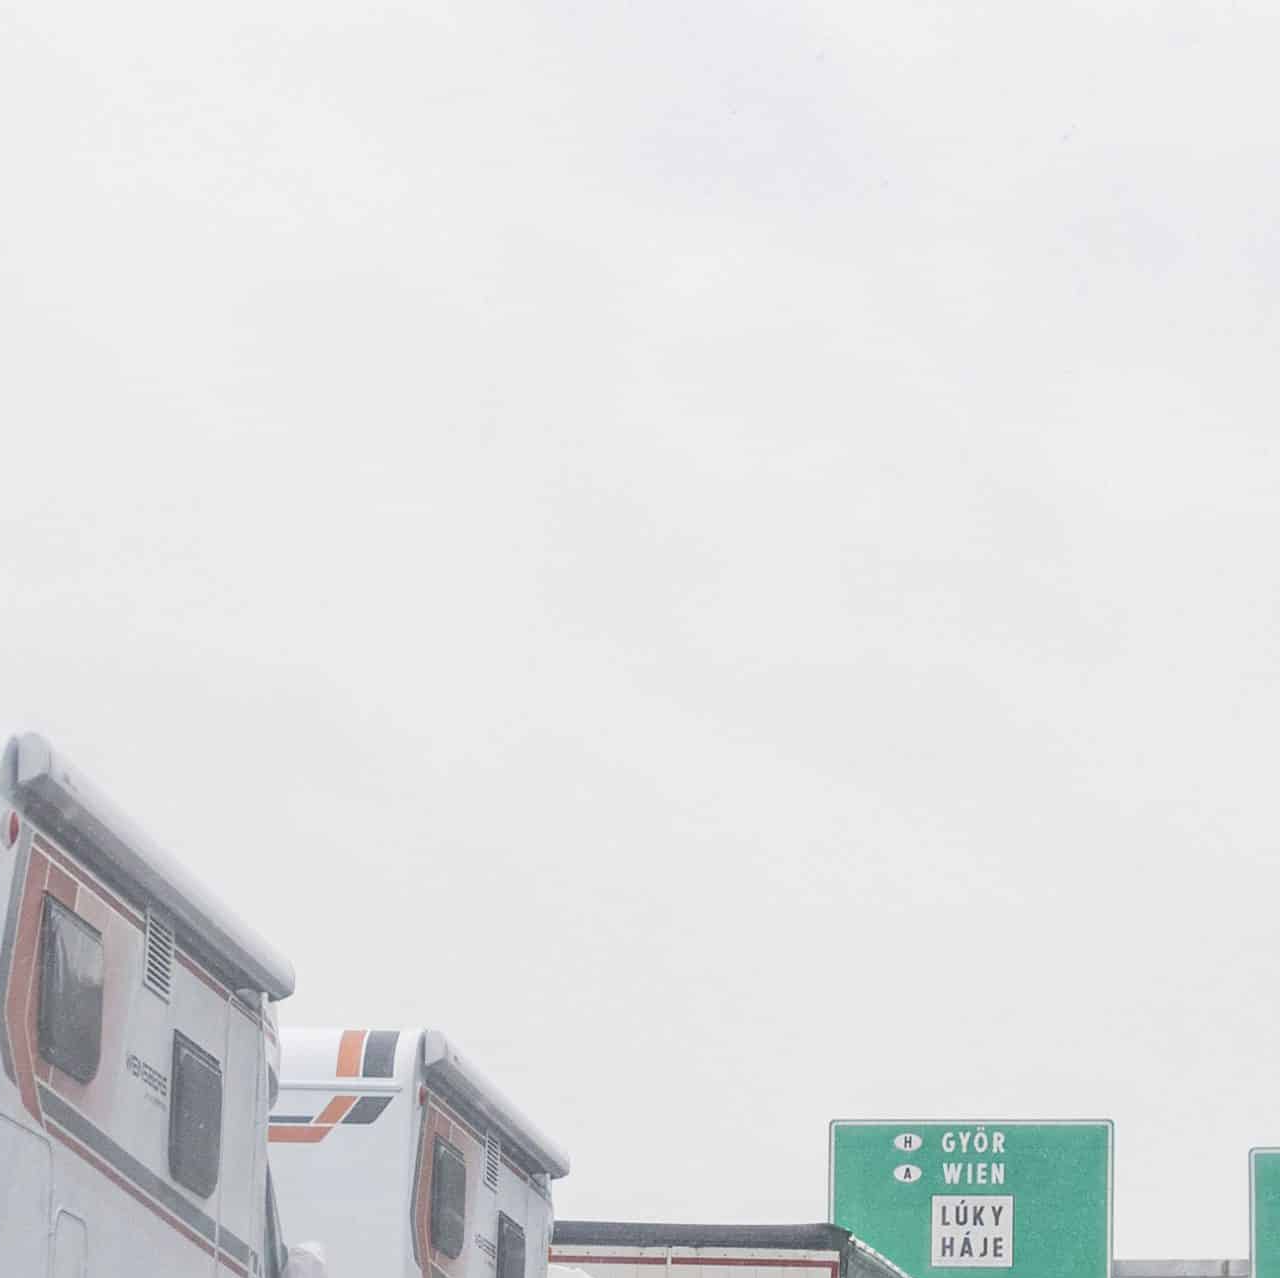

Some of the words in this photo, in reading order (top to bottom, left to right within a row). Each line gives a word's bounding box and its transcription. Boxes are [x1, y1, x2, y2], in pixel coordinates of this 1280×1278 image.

[904, 1136, 913, 1149] H
[903, 1167, 913, 1180] A
[942, 1163, 1005, 1184] WIEN
[940, 1200, 1004, 1226] LÚKY
[940, 1231, 1004, 1257] HÁJE
